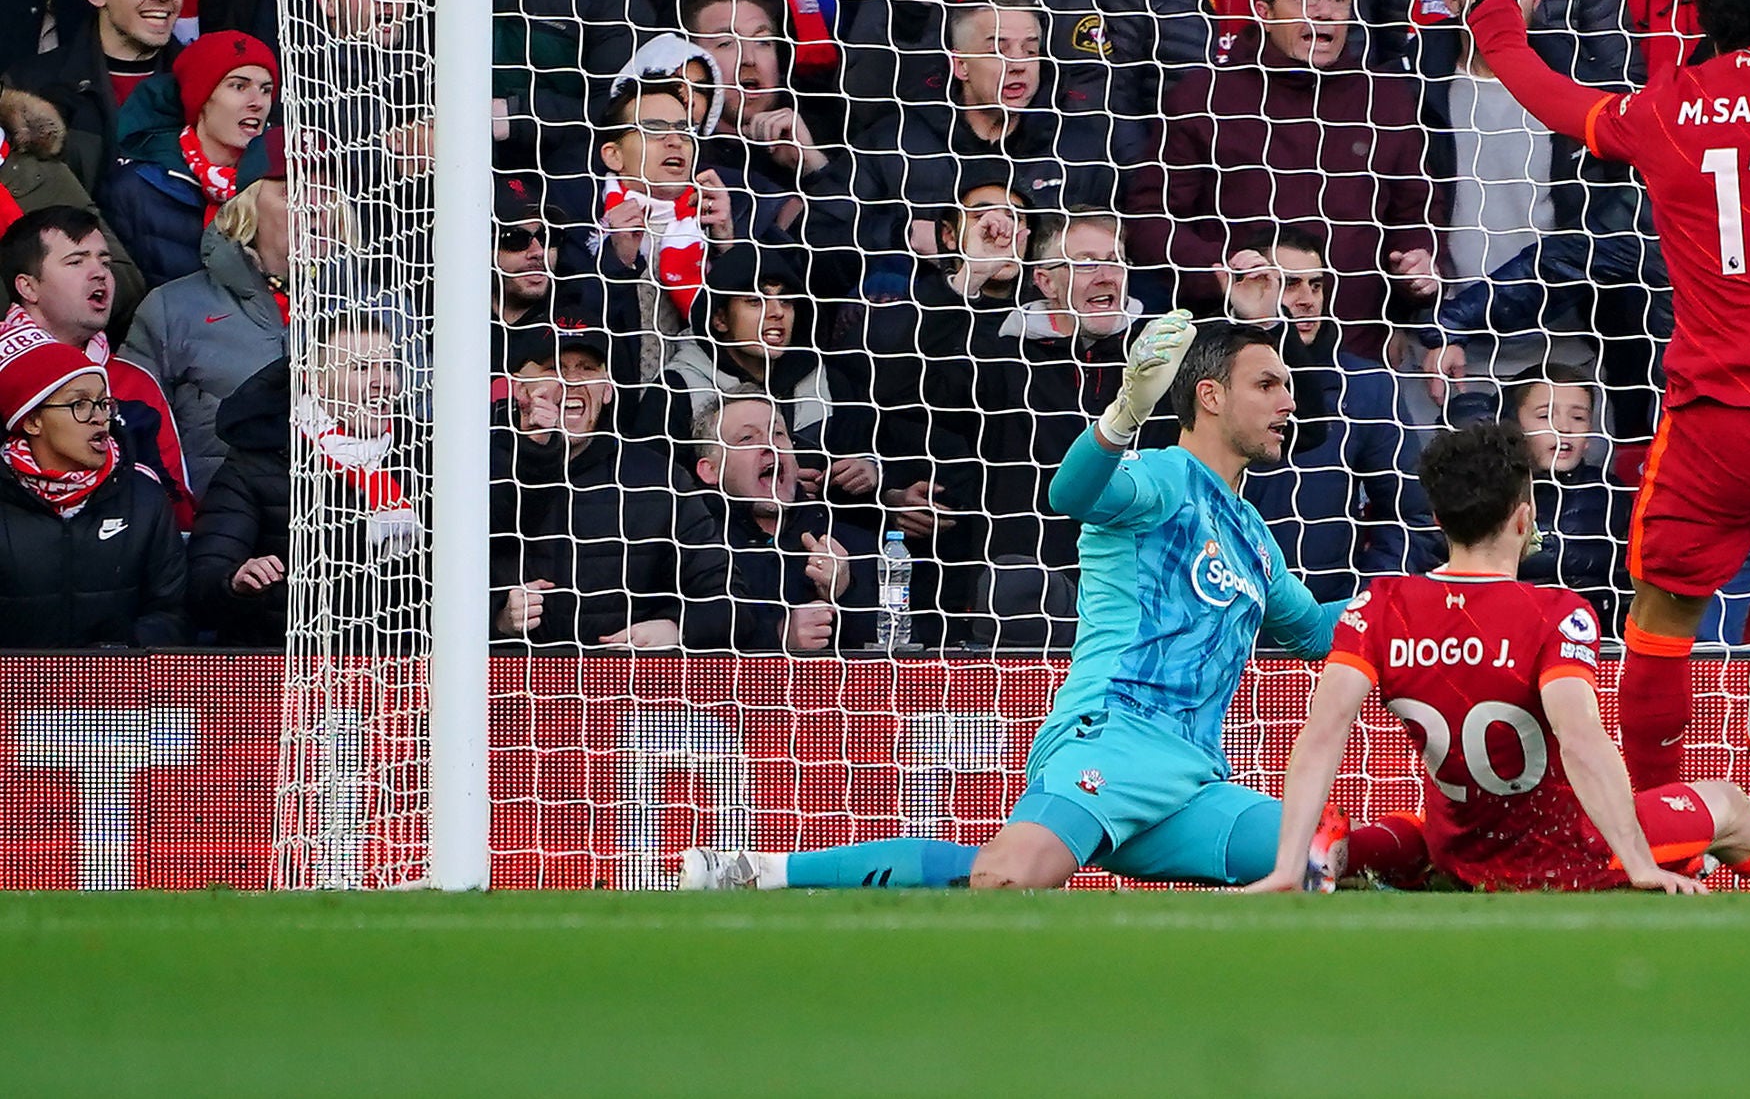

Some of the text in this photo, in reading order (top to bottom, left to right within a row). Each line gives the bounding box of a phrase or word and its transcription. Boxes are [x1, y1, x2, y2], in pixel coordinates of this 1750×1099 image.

[1389, 637, 1516, 668] DIOGO J.
[1387, 697, 1548, 803] 20
